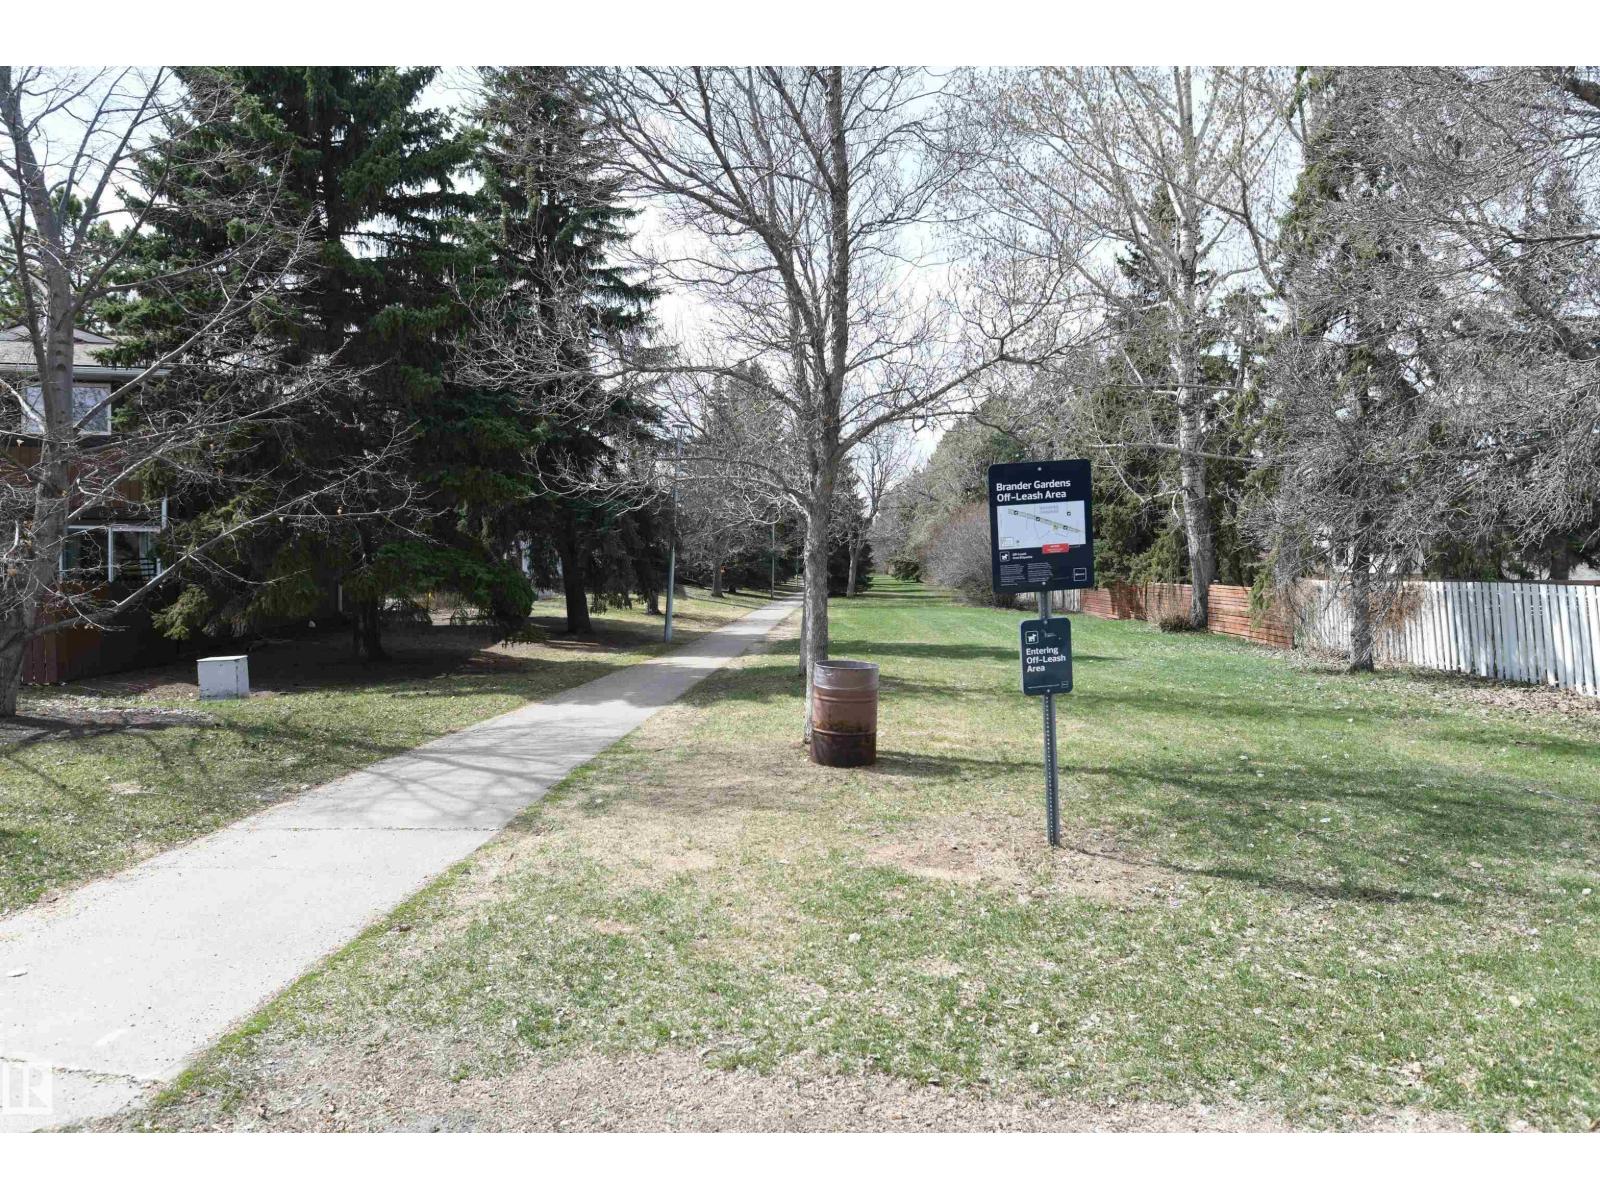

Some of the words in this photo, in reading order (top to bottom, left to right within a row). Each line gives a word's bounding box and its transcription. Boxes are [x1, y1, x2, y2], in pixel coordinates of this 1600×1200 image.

[996, 481, 1032, 491] Brander
[1034, 479, 1071, 489] Gardens
[996, 491, 1043, 502] Off-Leash
[1045, 490, 1067, 499] Area
[1026, 646, 1059, 655] Entering
[1026, 654, 1066, 664] Off-Leash
[1027, 665, 1046, 673] Area
